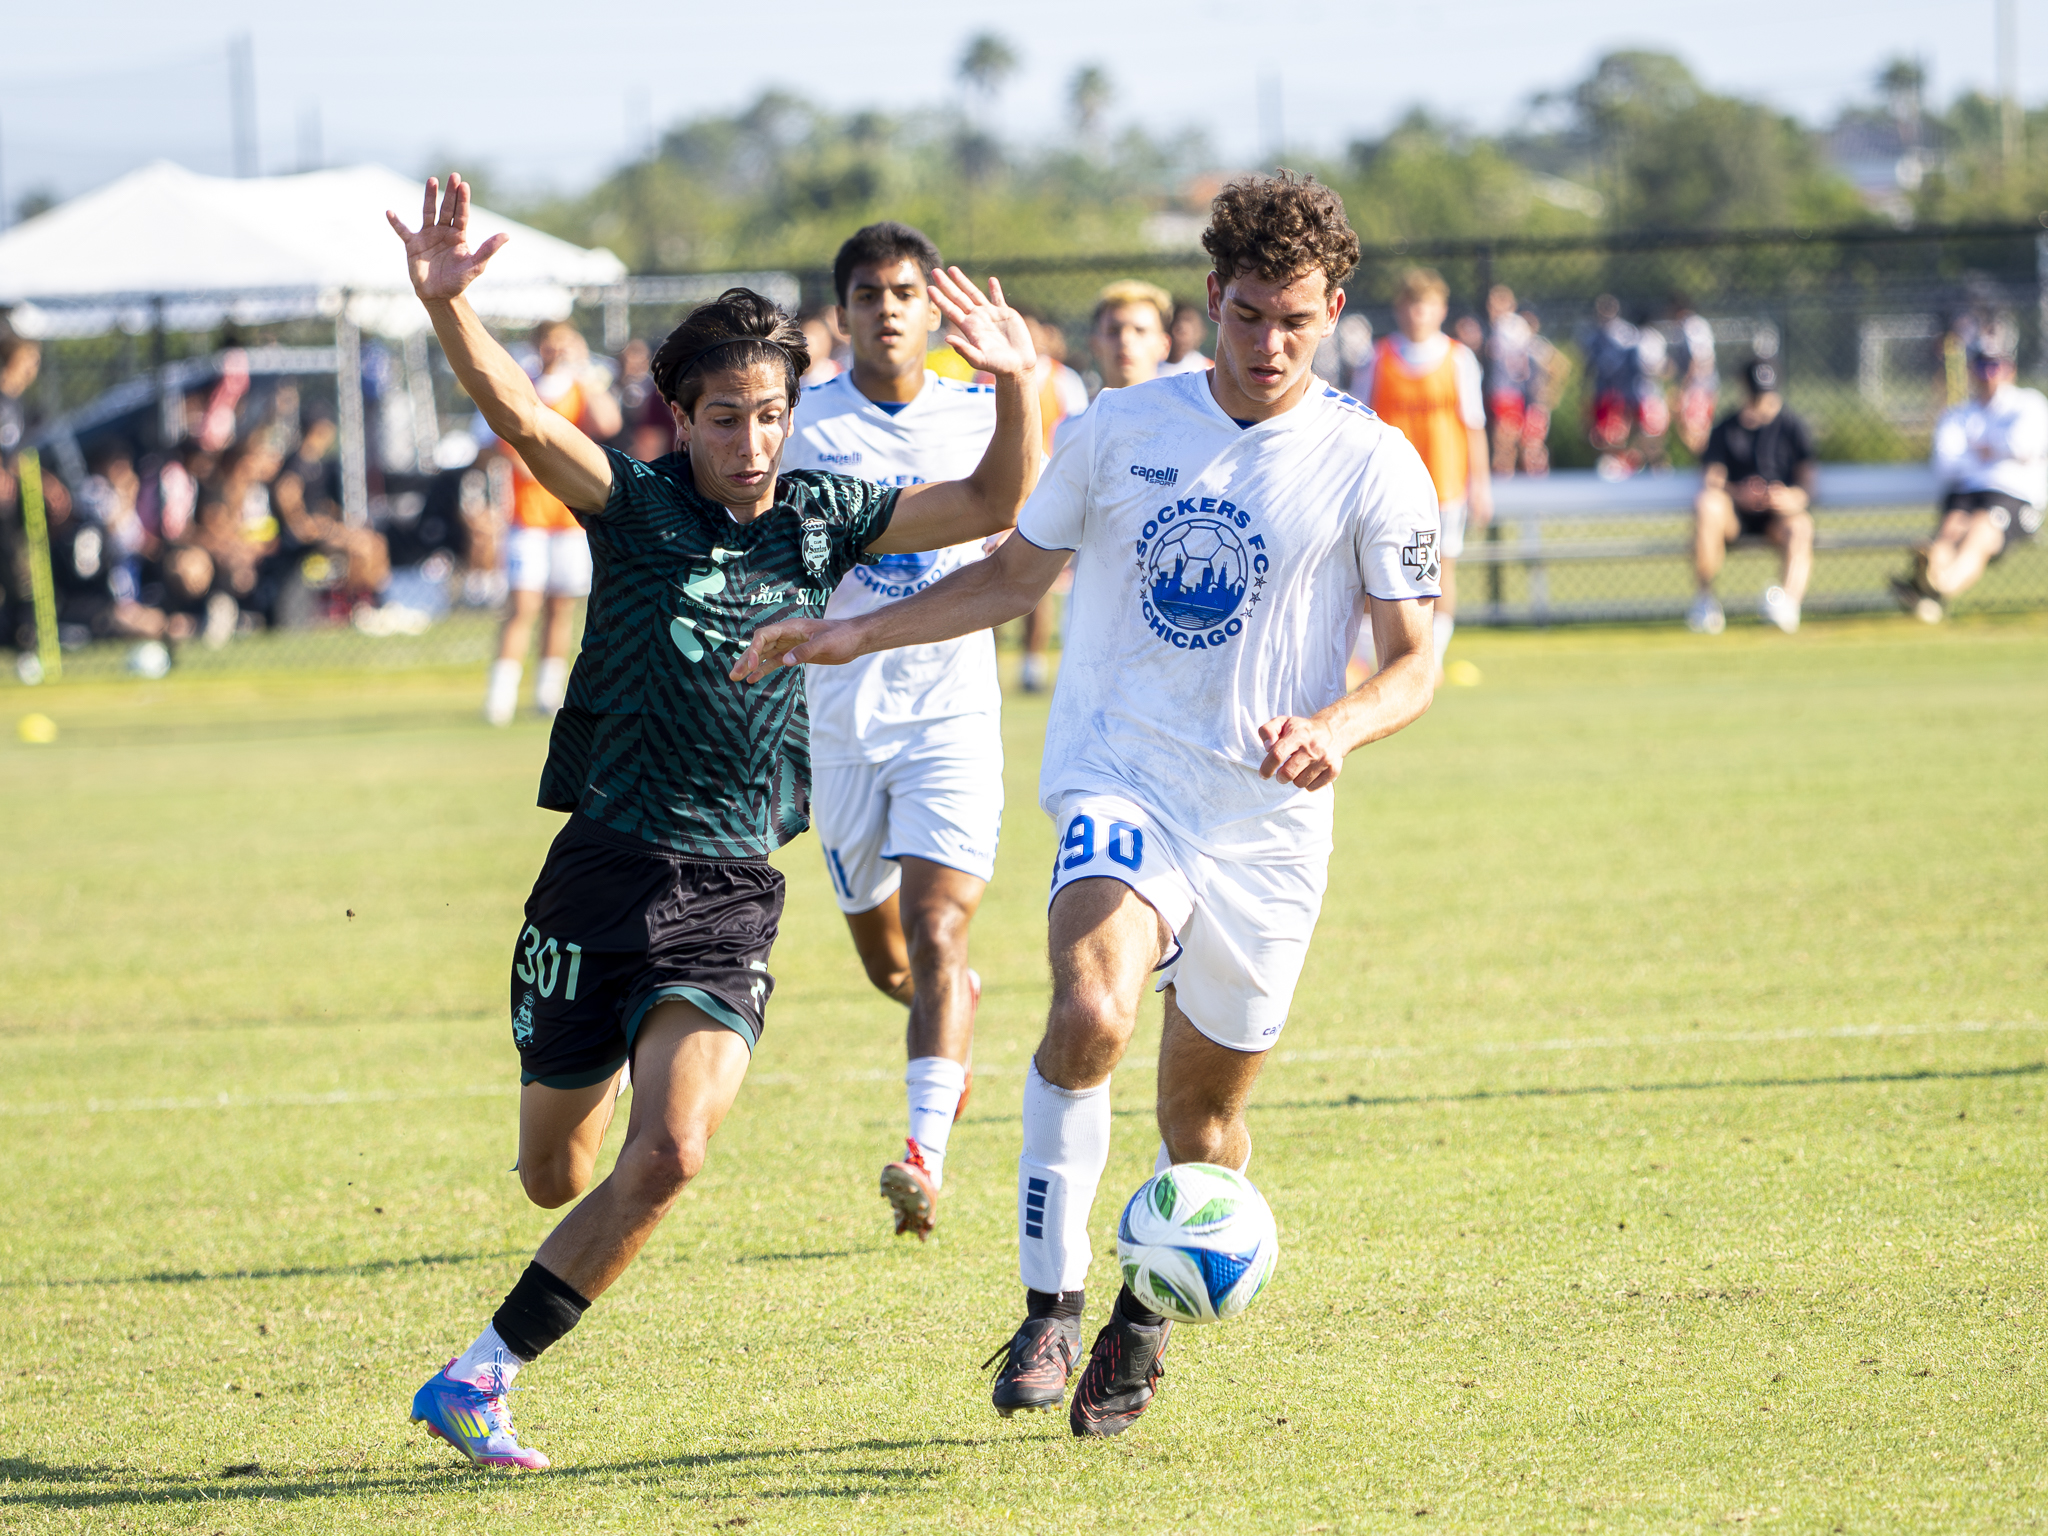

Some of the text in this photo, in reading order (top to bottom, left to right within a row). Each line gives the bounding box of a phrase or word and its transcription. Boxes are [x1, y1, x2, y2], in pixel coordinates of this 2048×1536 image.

[1130, 465, 1179, 482] capelli
[1149, 478, 1176, 488] SPORT
[1137, 497, 1270, 575] SOCKERS FC
[1142, 600, 1243, 650] CHICAGO
[1063, 814, 1144, 873] 90
[516, 924, 582, 1001] 301
